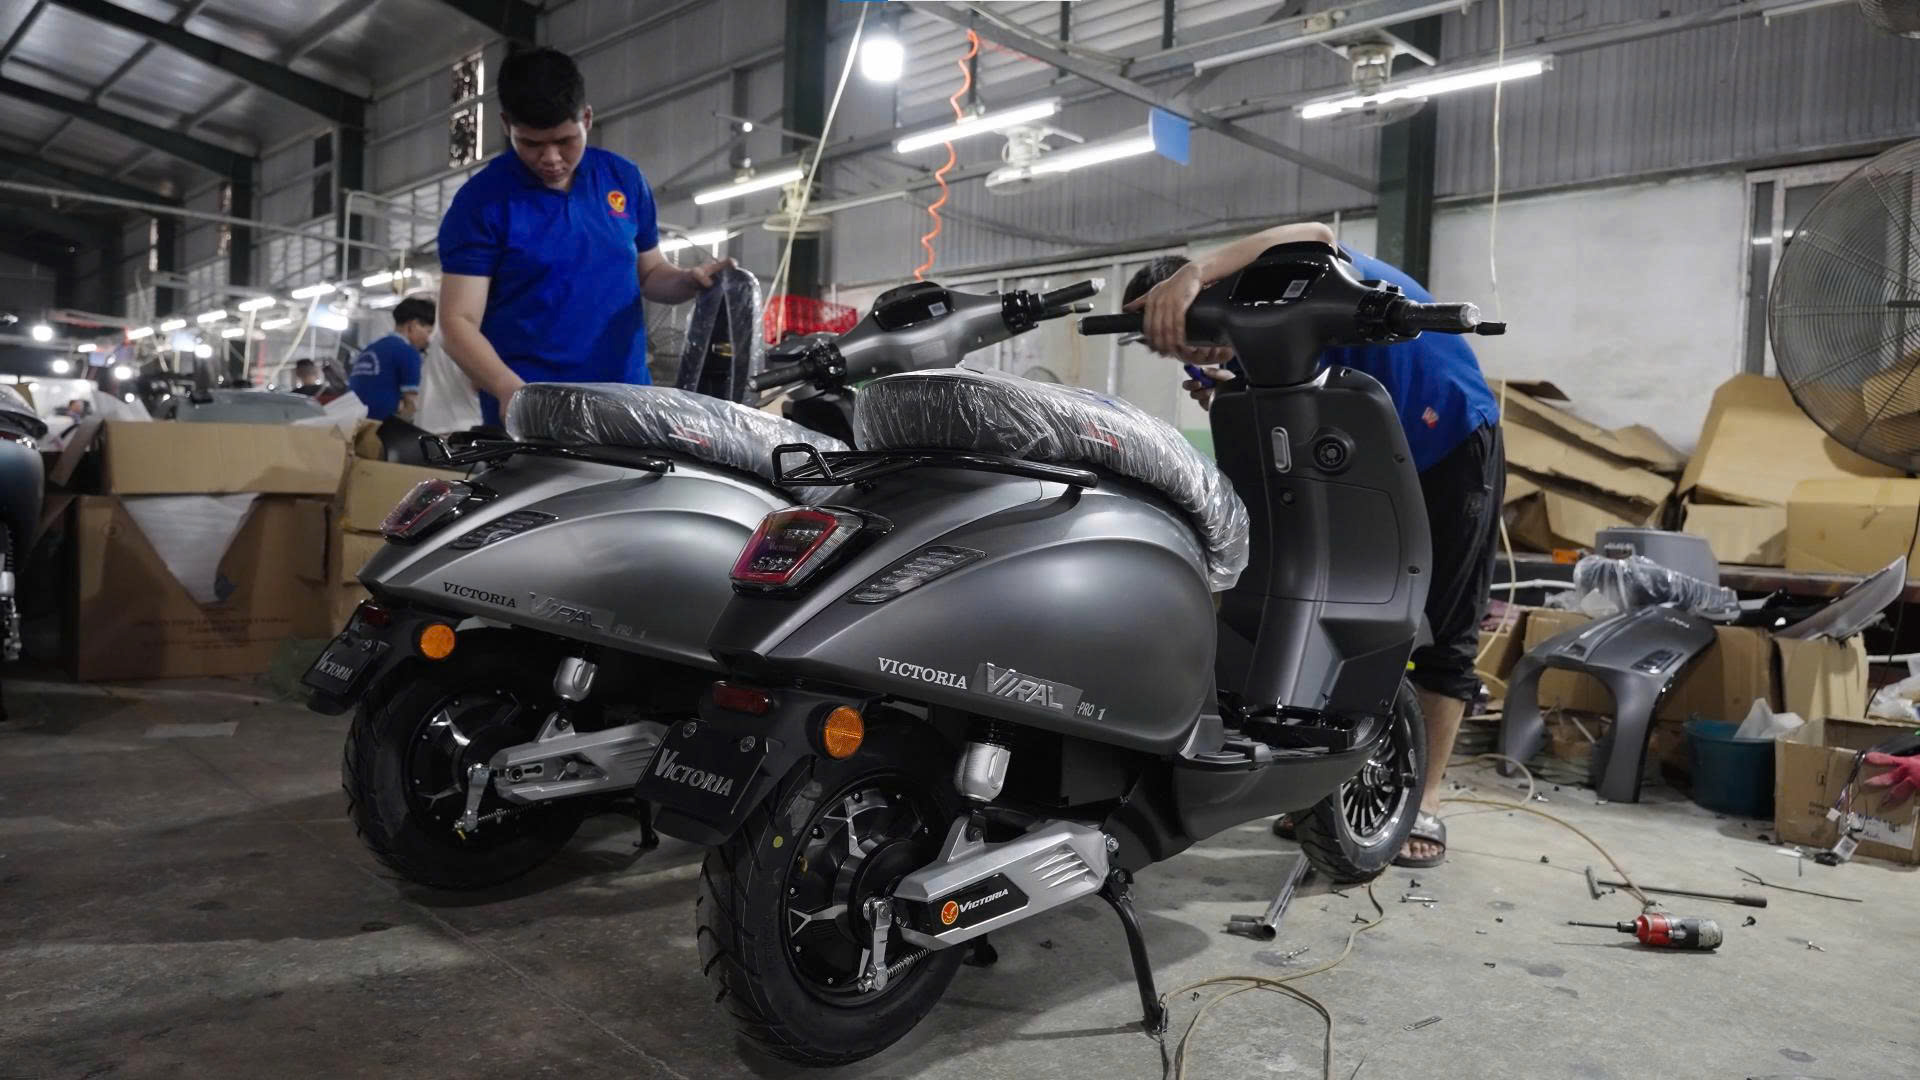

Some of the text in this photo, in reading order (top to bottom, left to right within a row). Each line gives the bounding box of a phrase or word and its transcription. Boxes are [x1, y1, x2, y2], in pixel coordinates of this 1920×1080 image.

[443, 582, 517, 608] VICTORIA
[528, 591, 603, 630] VIRAL
[314, 651, 353, 681] VICTORIA
[878, 656, 968, 690] VICTORIA
[987, 662, 1064, 710] VIRAL
[1097, 708, 1106, 721] 1
[655, 747, 734, 797] VICTORIA
[959, 888, 1009, 913] VICTORIA
